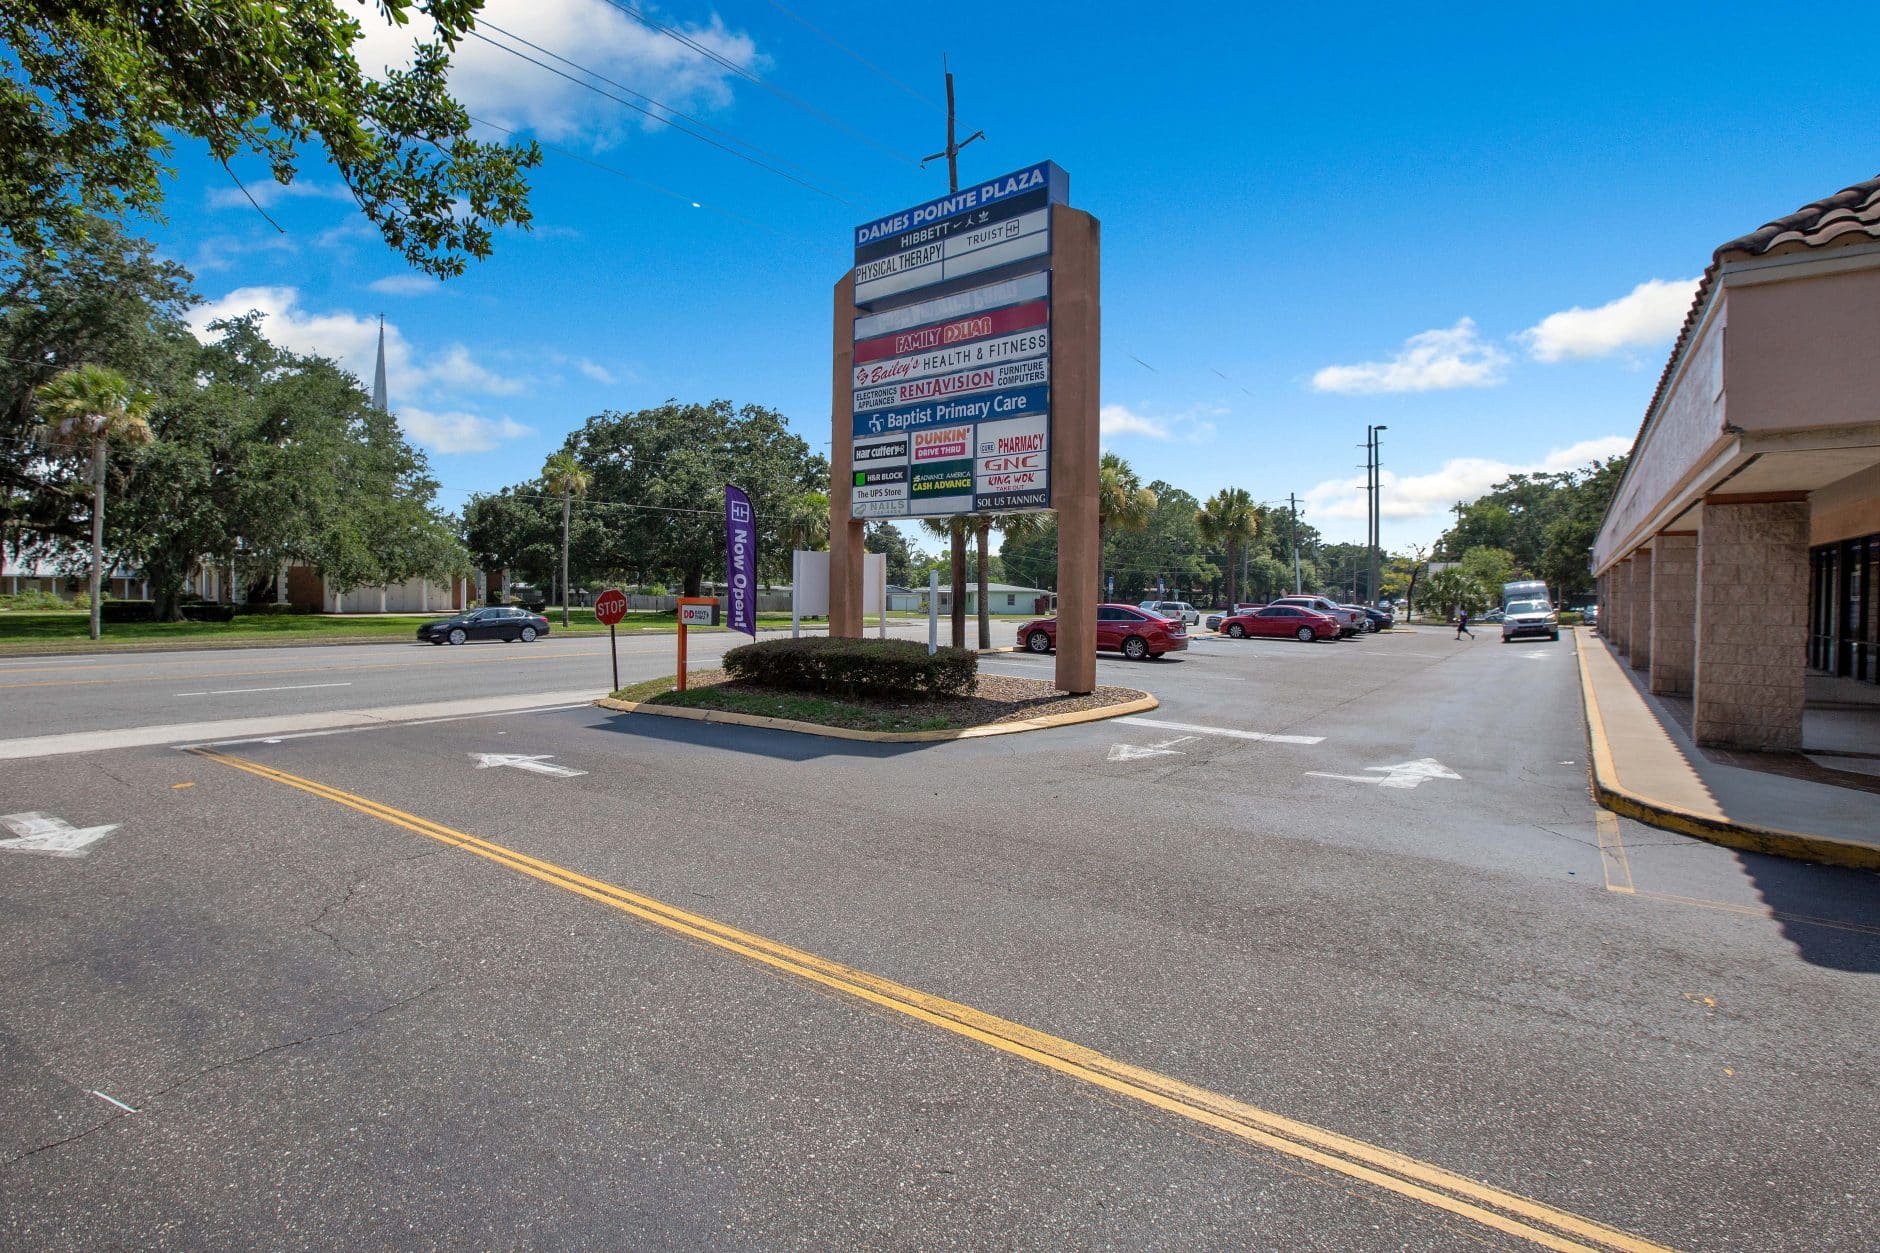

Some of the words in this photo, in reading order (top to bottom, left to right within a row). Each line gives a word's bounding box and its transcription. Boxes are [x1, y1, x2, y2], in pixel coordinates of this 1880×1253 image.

[858, 215, 909, 243] DAMES
[913, 191, 977, 226] POINTE
[981, 169, 1044, 202] PLAZA
[901, 222, 950, 248] HIBBETT
[967, 227, 1003, 246] TRUIST
[856, 259, 897, 283] PHYSICAL
[899, 243, 942, 269] THERAPY
[895, 328, 940, 354] FAMILY
[943, 317, 991, 343] DOLLAR
[871, 357, 920, 383] Bailey's
[923, 351, 970, 370] HEALTH
[977, 348, 983, 360] &
[989, 335, 1046, 358] FITNESS
[999, 362, 1044, 376] FURNITURE
[997, 370, 1045, 386] COMPUTERS
[856, 387, 897, 402] ELECTRONICS
[858, 397, 895, 409] APPLIANCES
[888, 408, 932, 429] Baptist
[936, 401, 990, 421] Primary
[994, 395, 1027, 412] Care
[915, 427, 970, 446] DUNKIN'
[998, 434, 1044, 453] PHARMACY
[918, 448, 939, 457] DRIVE
[941, 445, 961, 454] THRU
[984, 454, 1038, 471] GNC
[882, 472, 903, 480] BLOCK
[912, 481, 933, 491] CASH
[934, 478, 972, 489] ADVANCE
[920, 473, 944, 481] ADVANCE
[988, 476, 1011, 485] KING
[1014, 473, 1034, 483] WOK
[871, 489, 882, 497] UPS
[978, 498, 992, 507] SOL
[1006, 494, 1045, 505] TANNING
[870, 501, 904, 511] NAILS
[734, 529, 747, 570] Now
[598, 600, 625, 617] STOP
[732, 574, 747, 628] Open!
